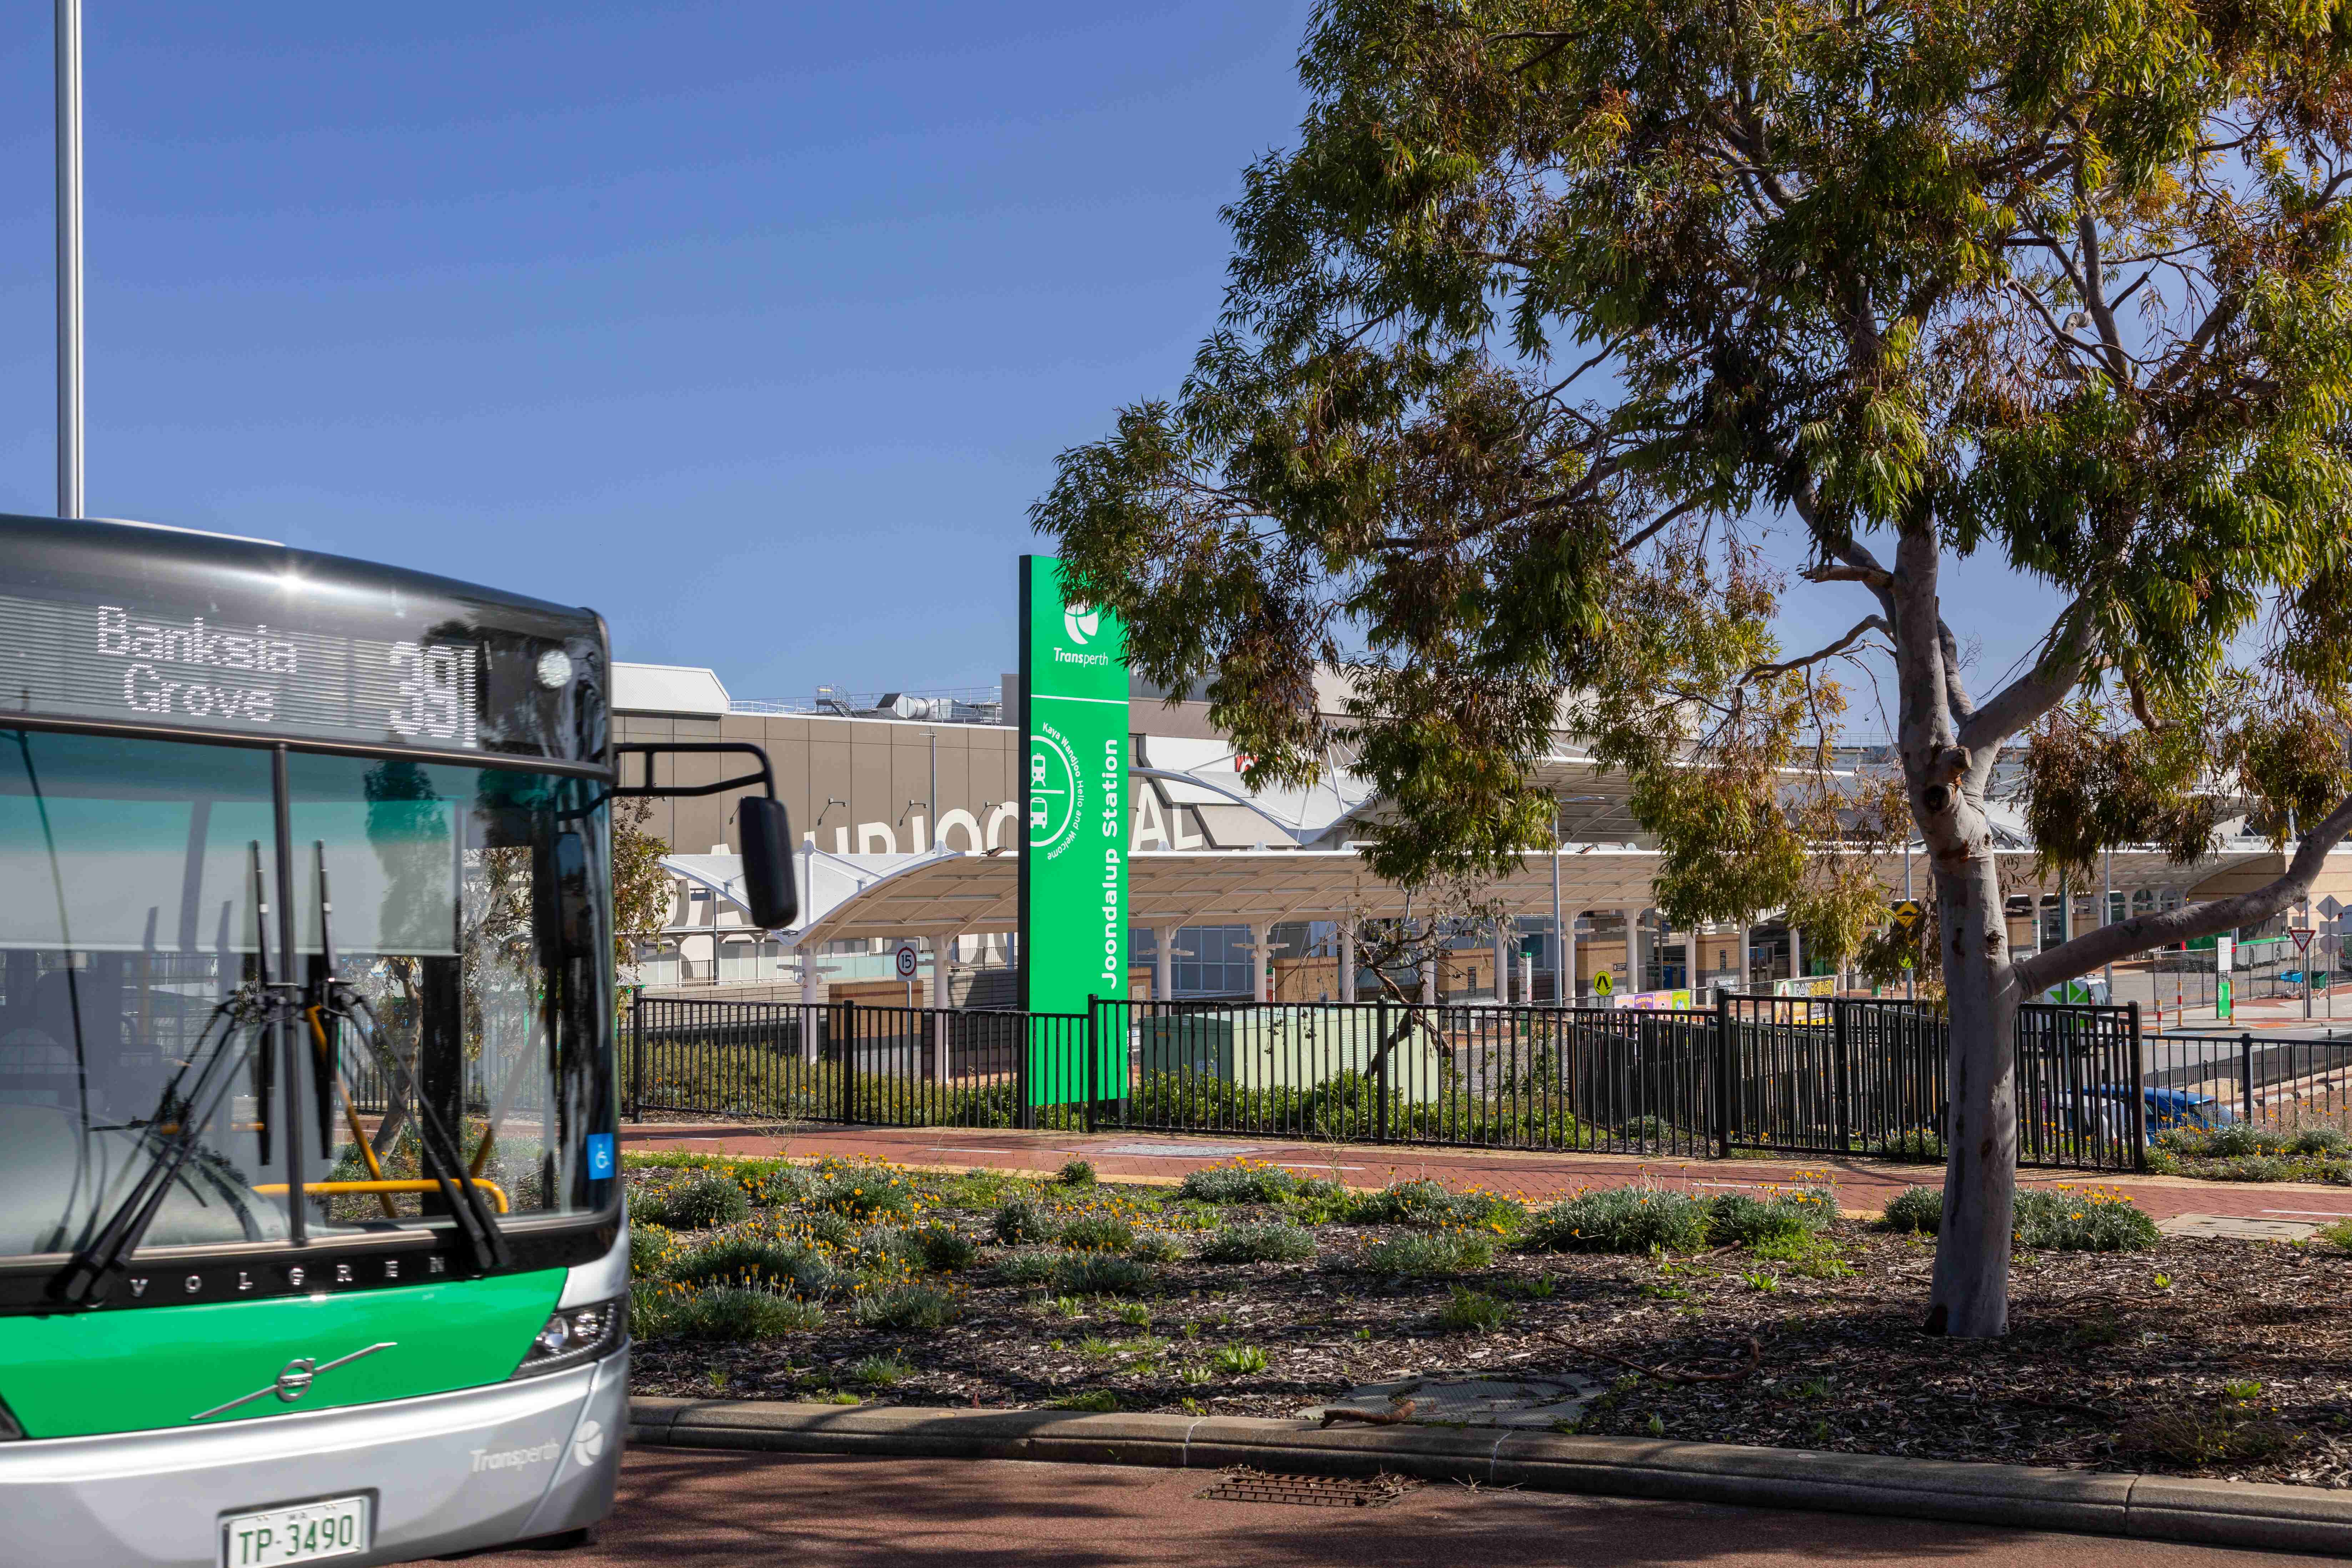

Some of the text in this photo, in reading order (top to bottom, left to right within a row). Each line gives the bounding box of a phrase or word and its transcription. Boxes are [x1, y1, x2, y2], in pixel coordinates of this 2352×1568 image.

[97, 605, 297, 673] Banksia
[1054, 647, 1108, 668] Transperth
[124, 663, 273, 722] Grove
[390, 641, 476, 741] 391
[1042, 722, 1084, 860] Kaya Wandjoo Hello and Welcome
[1102, 739, 1120, 989] Joondalup Station
[901, 955, 911, 969] 15
[130, 1256, 445, 1297] VOLGREN
[470, 1437, 560, 1473] Transperth
[238, 1514, 353, 1564] TP-3490
